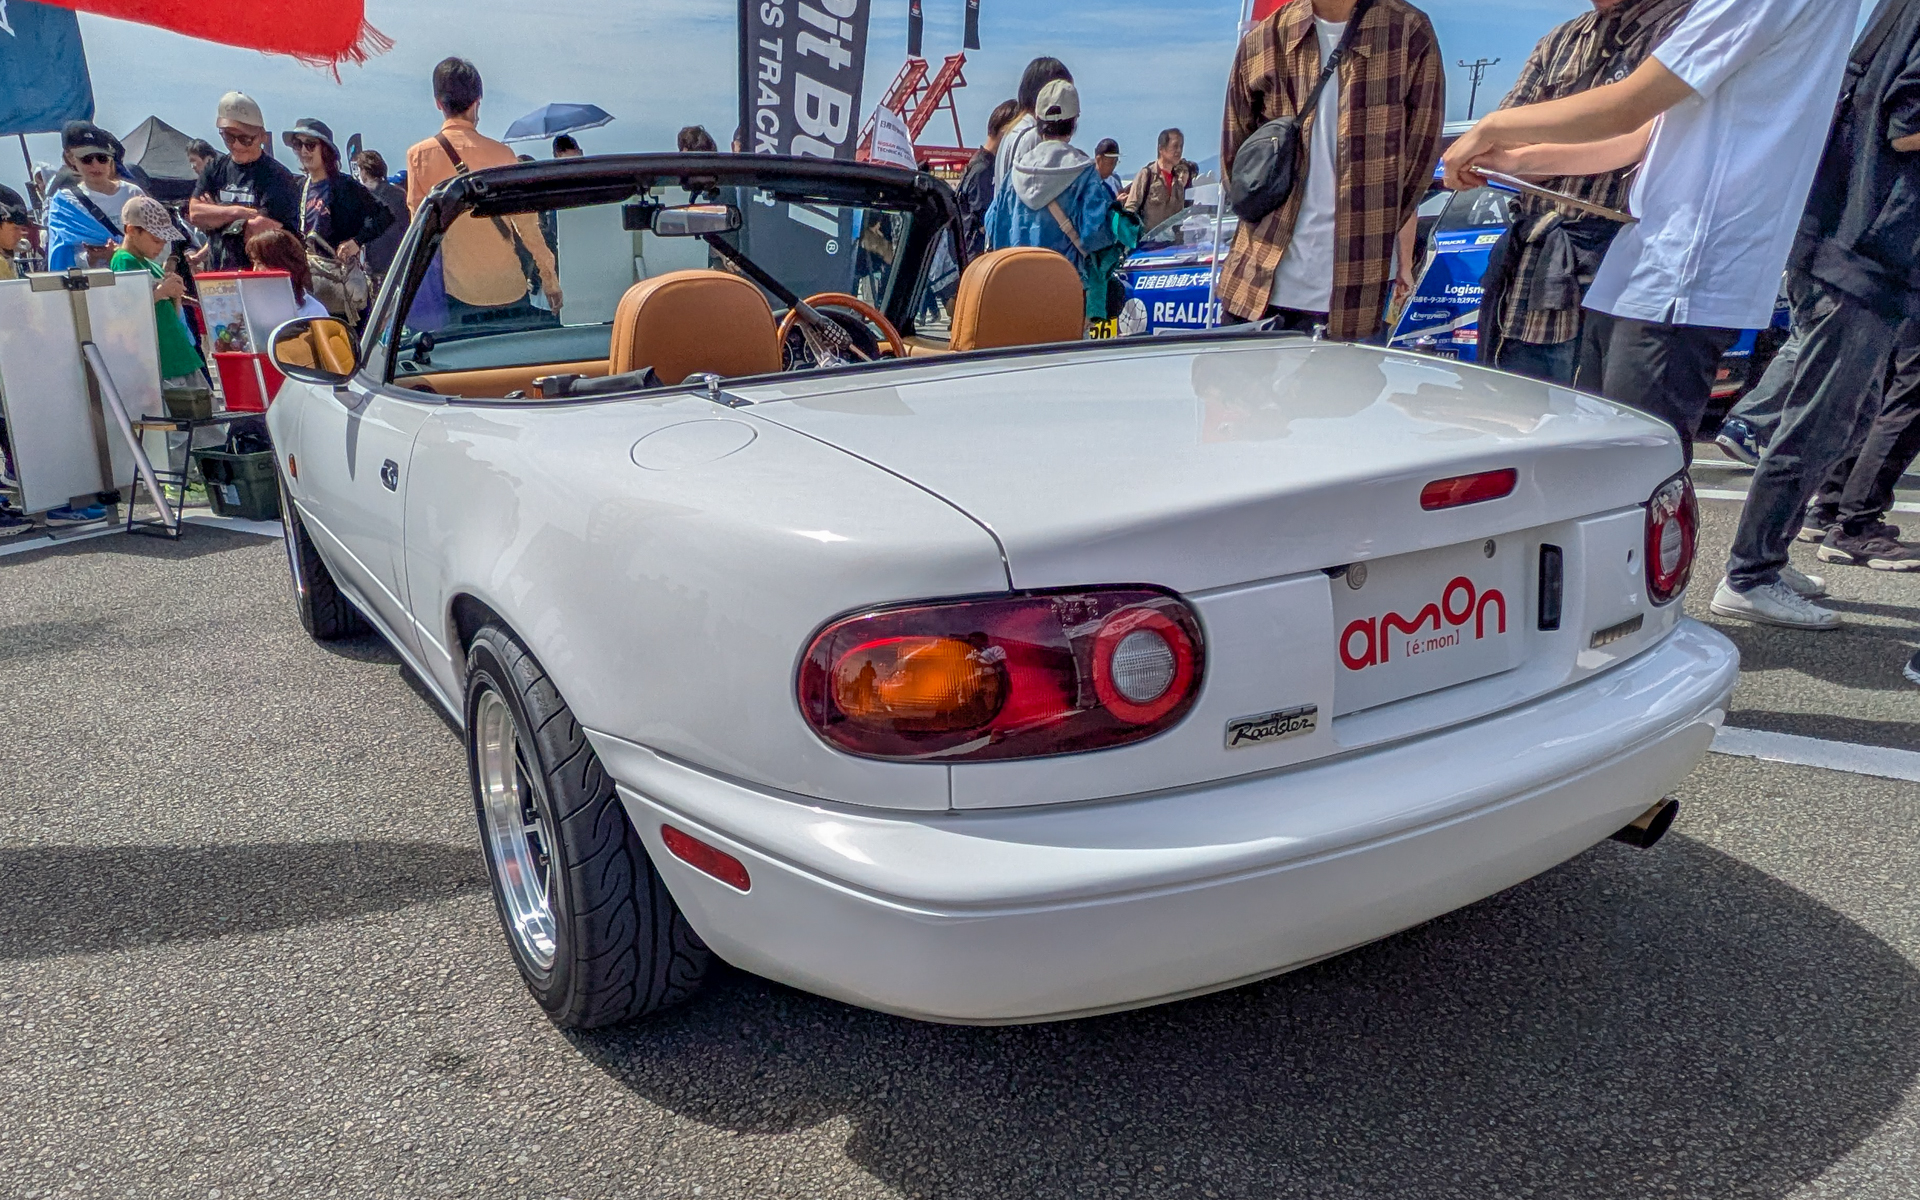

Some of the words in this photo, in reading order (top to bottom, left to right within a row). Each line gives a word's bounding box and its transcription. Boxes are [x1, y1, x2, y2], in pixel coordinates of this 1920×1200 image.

[753, 38, 783, 207] TRACKR
[1340, 576, 1506, 671] amon
[1231, 718, 1315, 746] Roadster
